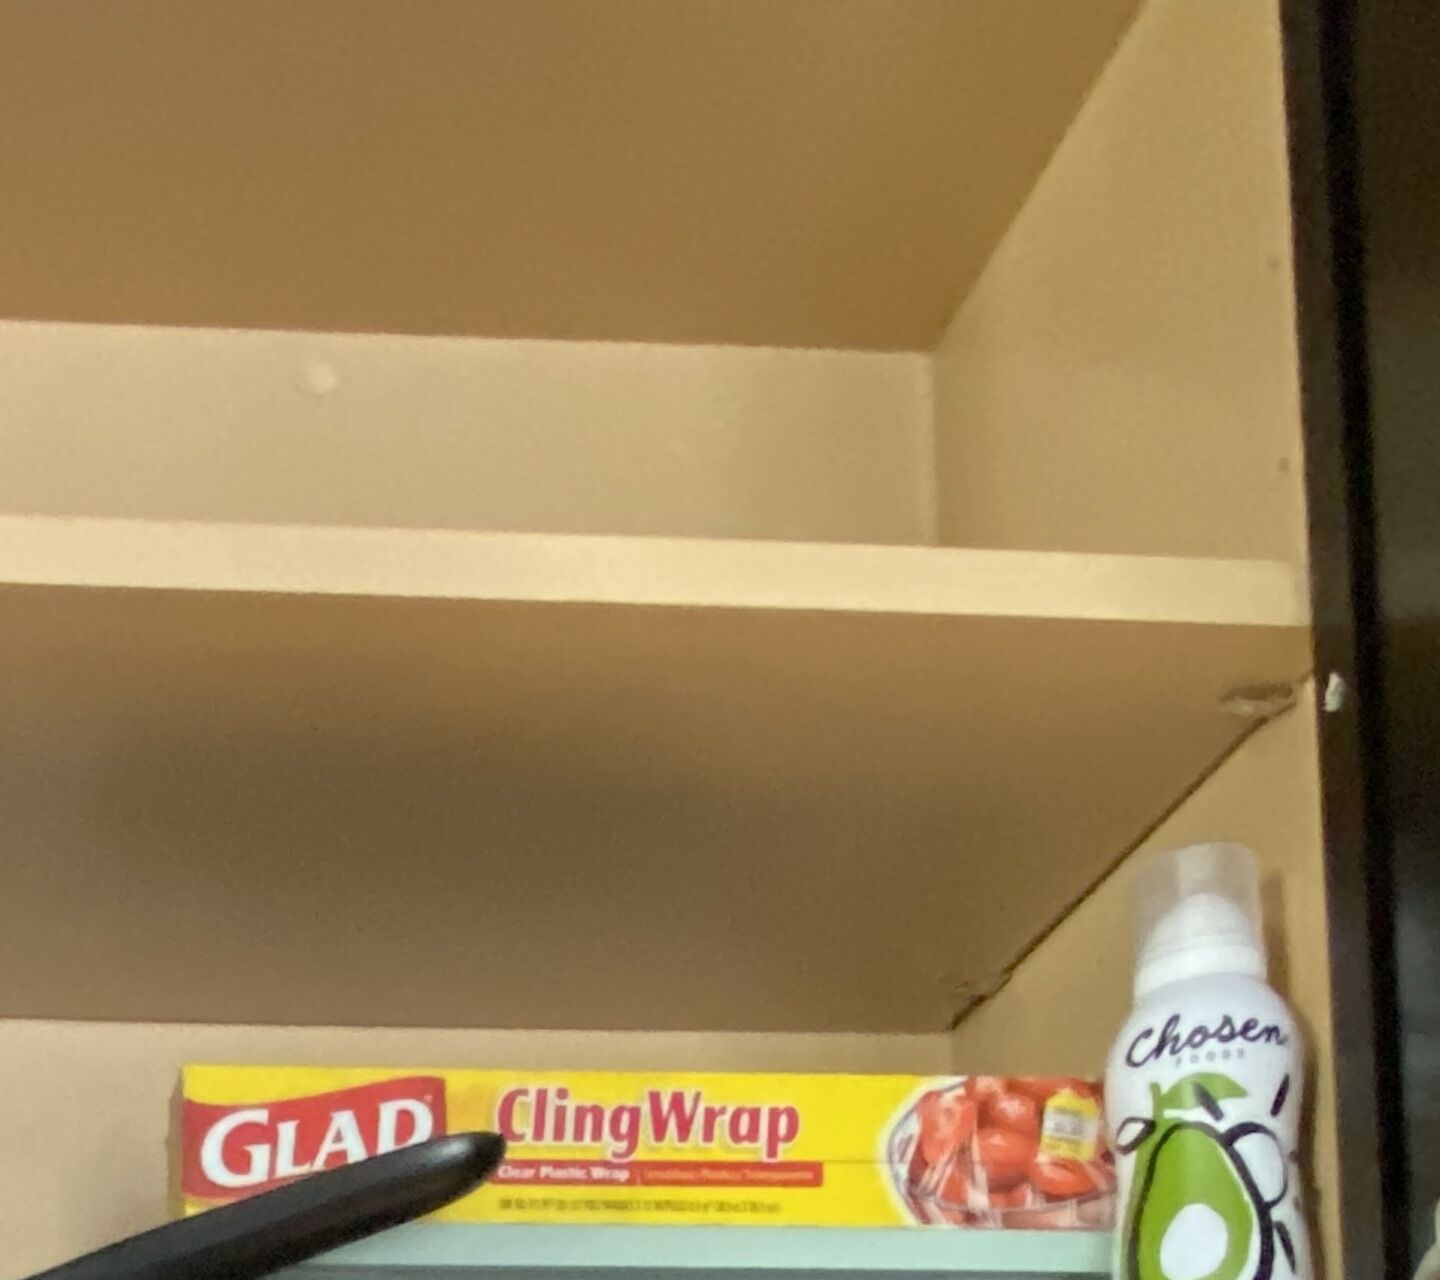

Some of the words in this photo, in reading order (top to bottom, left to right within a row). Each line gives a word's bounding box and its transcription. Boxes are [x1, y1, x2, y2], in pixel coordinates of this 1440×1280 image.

[1125, 1013, 1289, 1068] Chosen
[200, 1098, 434, 1188] GLAD
[497, 1086, 800, 1160] ClingWrap
[496, 1164, 536, 1180] Clear
[539, 1164, 588, 1180] Plastic
[590, 1166, 631, 1183] Wrap
